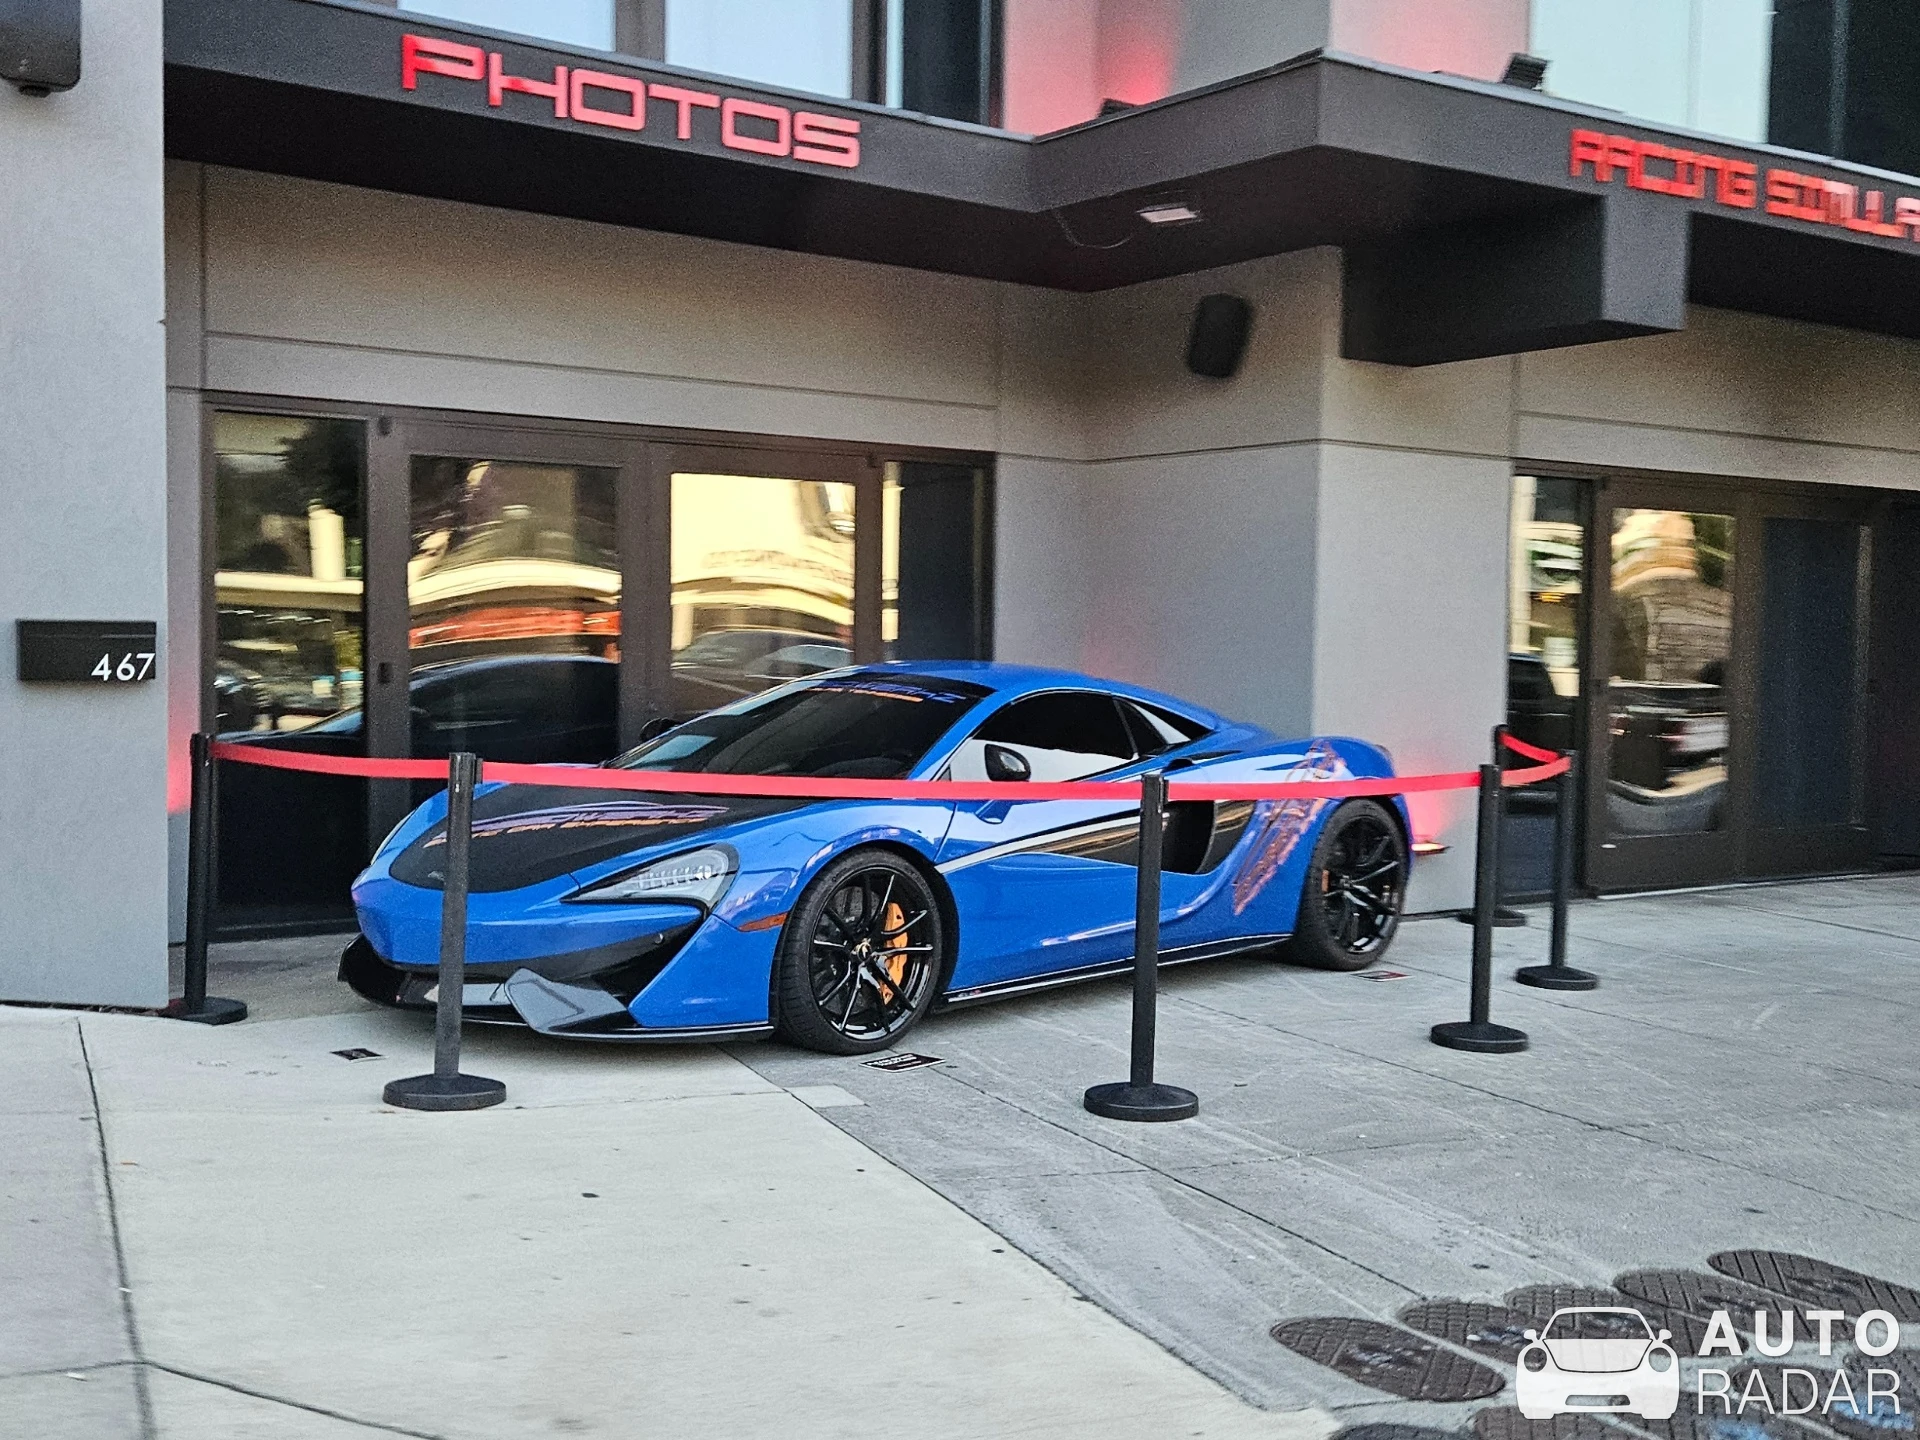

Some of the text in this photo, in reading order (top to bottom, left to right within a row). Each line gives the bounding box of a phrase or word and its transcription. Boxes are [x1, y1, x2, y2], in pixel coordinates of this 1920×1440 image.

[402, 33, 860, 168] PHOTOS
[1570, 128, 1757, 209] RACING
[91, 652, 156, 682] 467
